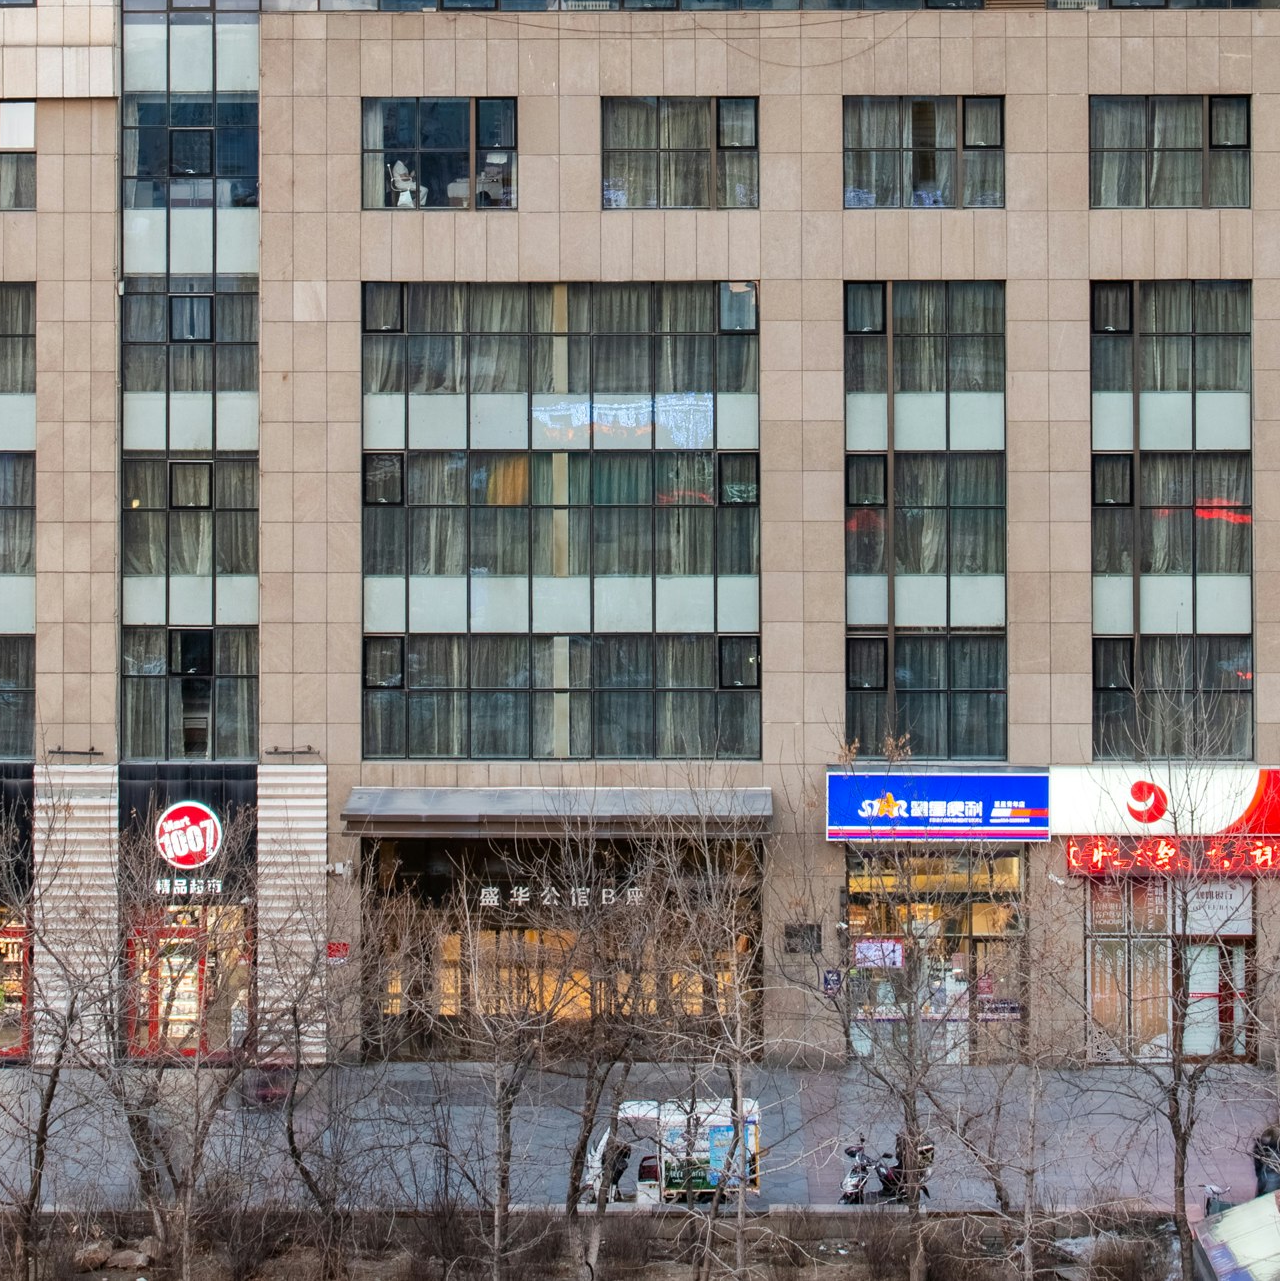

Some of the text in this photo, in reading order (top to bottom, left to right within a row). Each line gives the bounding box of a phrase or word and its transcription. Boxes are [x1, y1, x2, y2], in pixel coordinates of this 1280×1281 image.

[162, 815, 191, 832] Mart
[160, 819, 215, 858] 1007
[155, 879, 223, 895] 精品超市
[479, 886, 645, 907] 盛华公馆B座
